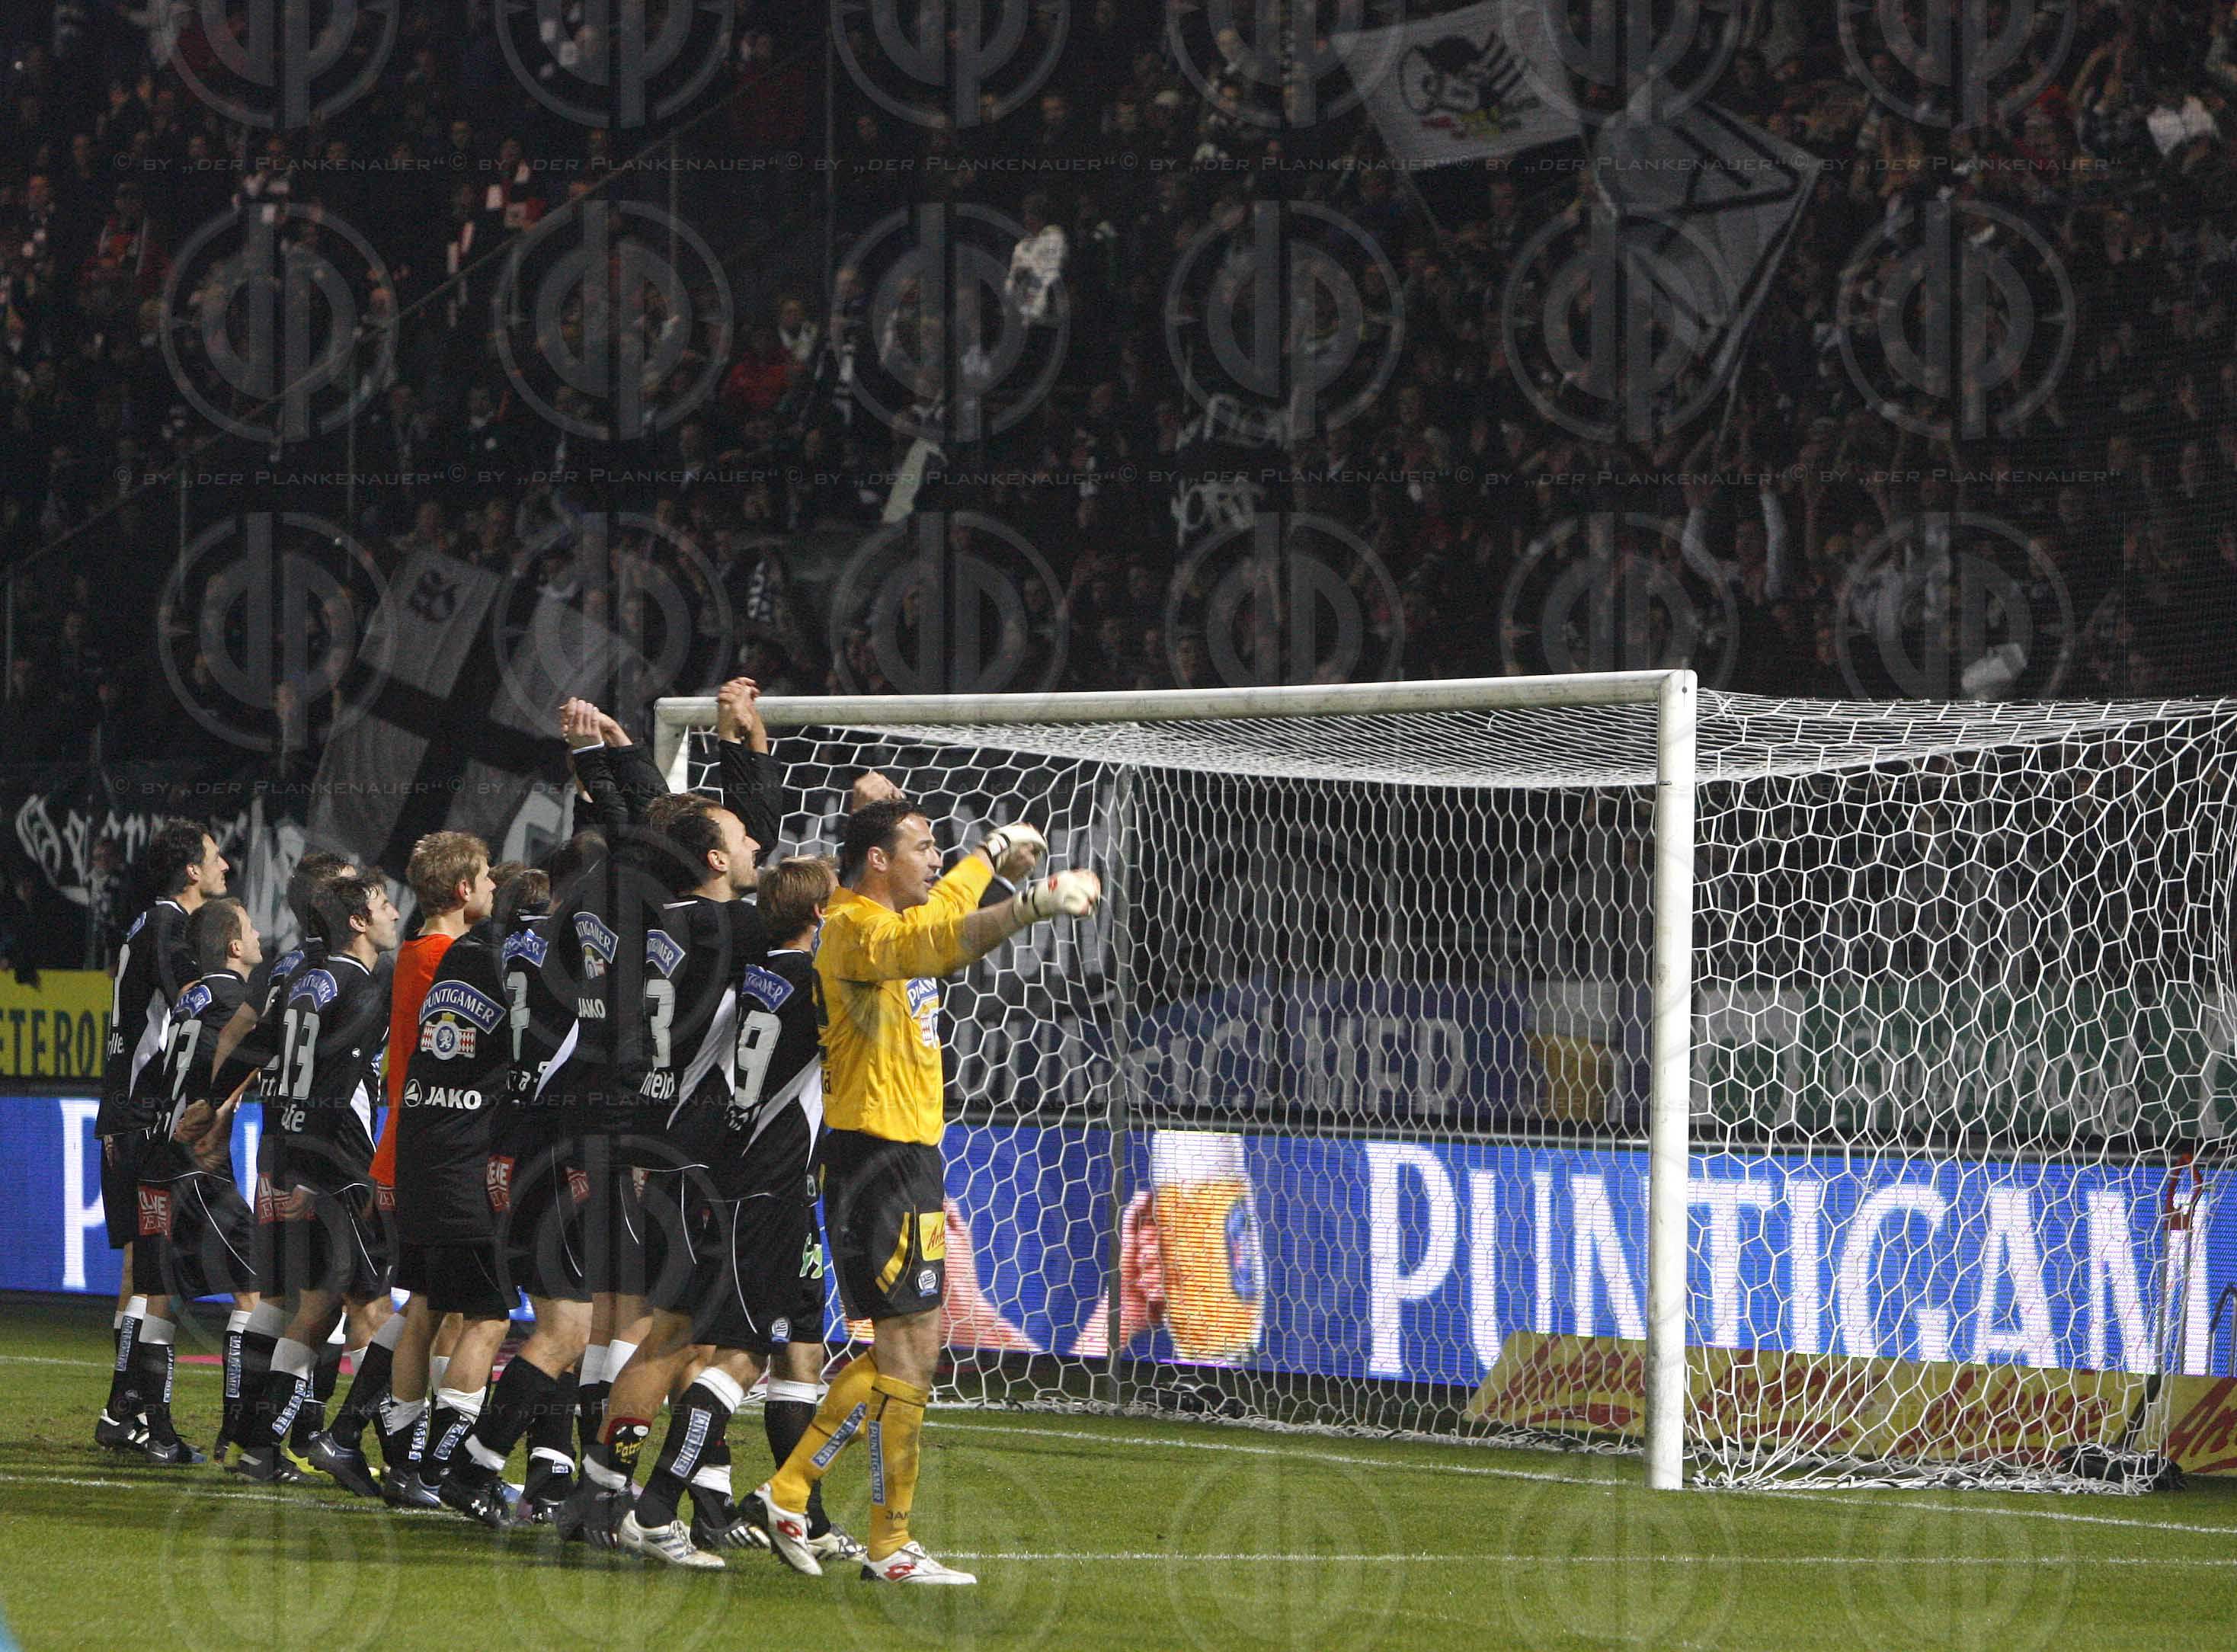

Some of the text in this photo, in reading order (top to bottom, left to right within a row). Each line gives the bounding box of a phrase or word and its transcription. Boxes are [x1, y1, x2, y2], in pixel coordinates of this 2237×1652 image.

[422, 988, 495, 1023] PUNTIGAMER
[577, 997, 606, 1019] JAKO
[0, 1008, 111, 1077] TERO
[277, 1008, 321, 1100] 13
[424, 1086, 482, 1109] JAKO
[1367, 1141, 2211, 1378] PUNTIGAM
[870, 1426, 884, 1503] PUNTIGAMER
